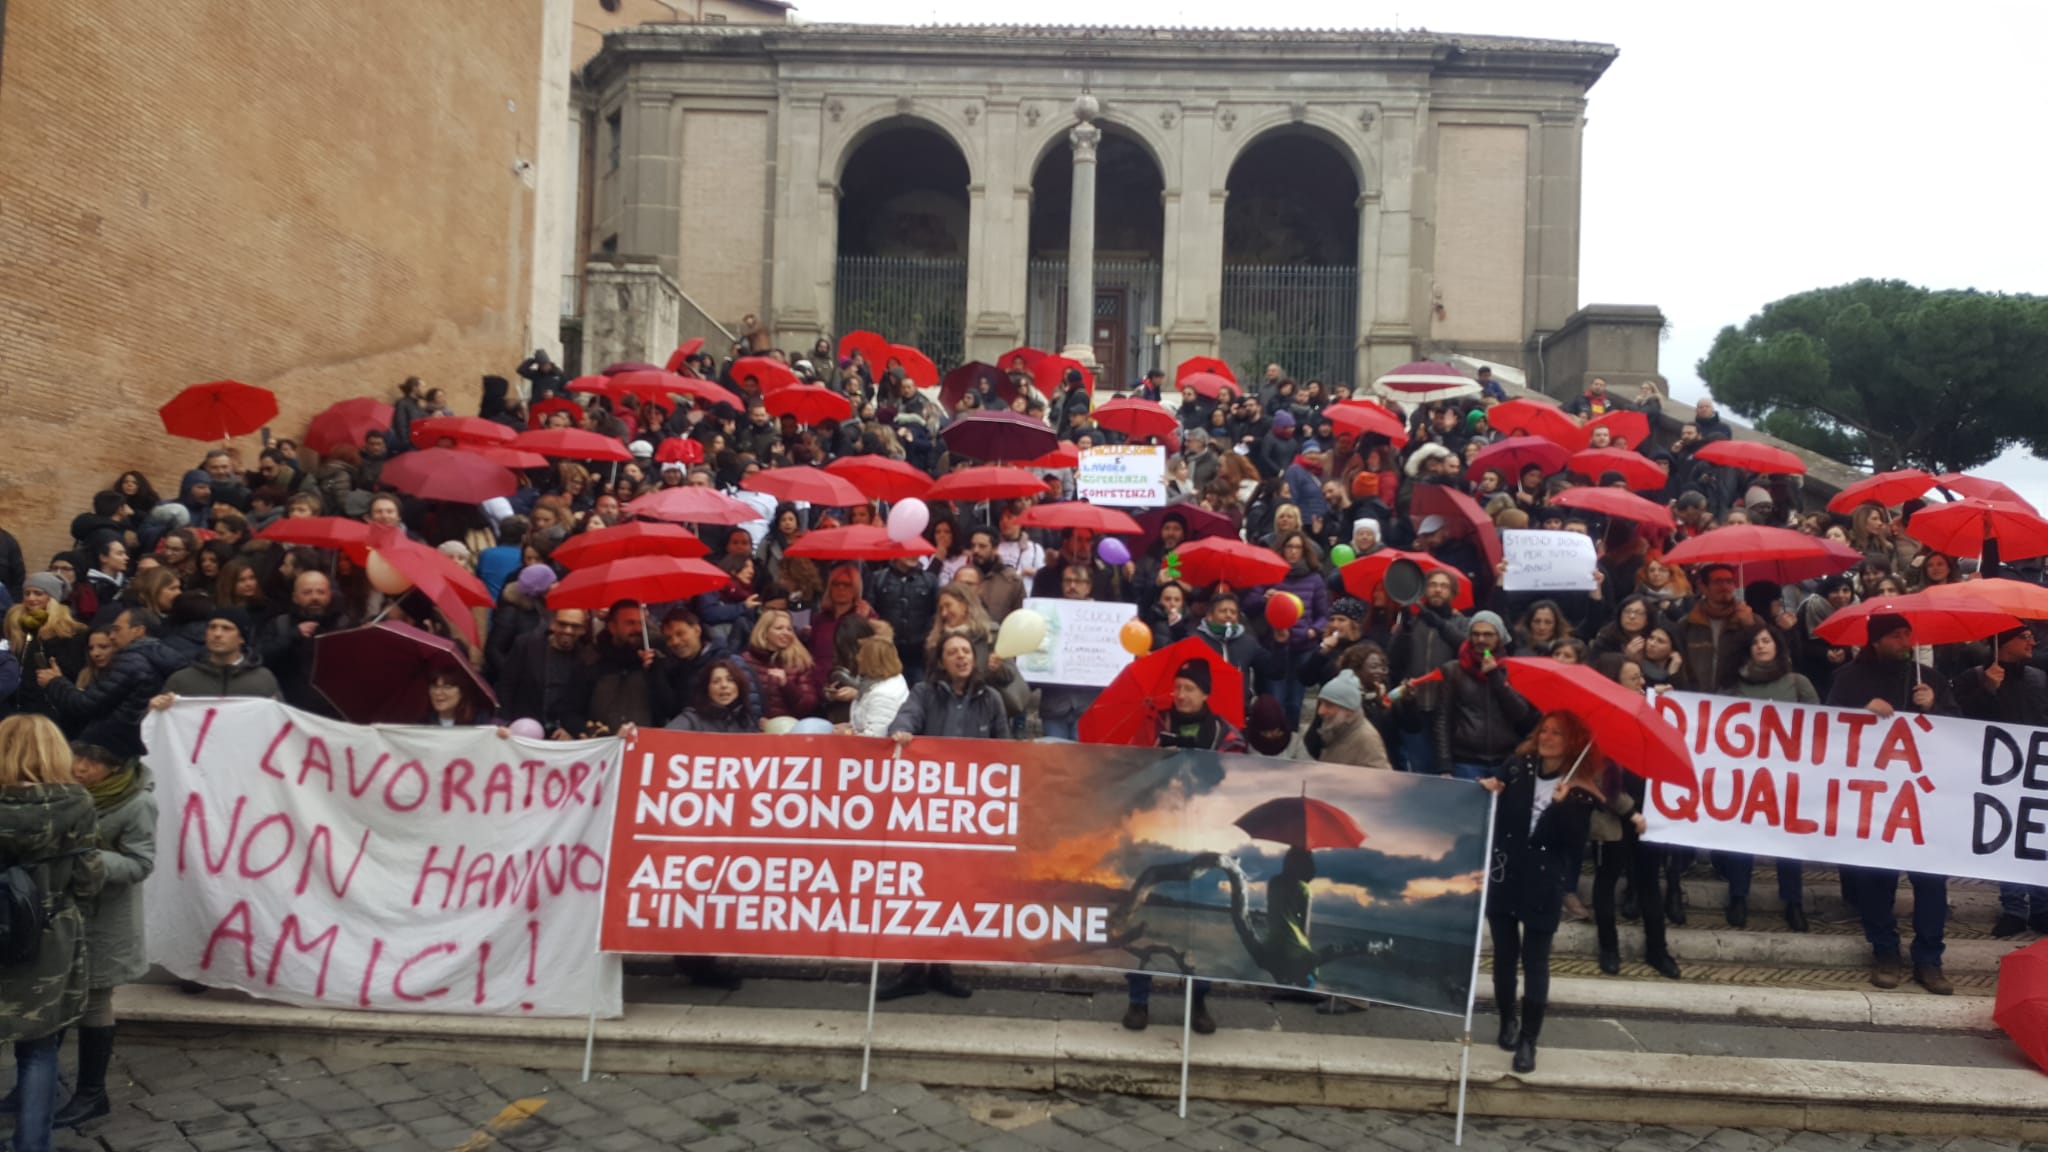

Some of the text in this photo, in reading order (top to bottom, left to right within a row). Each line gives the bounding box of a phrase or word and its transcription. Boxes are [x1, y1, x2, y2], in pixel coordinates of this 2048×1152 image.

[1080, 488, 1156, 499] COMPETENZA
[192, 708, 606, 813] I LAVORATORI
[640, 753, 1020, 798] I SERVIZI PUBBLICI
[635, 791, 1019, 835] NON SONO MERCI
[178, 792, 604, 912] NON HANNO
[627, 853, 925, 896] AEC/OEPA PER
[626, 892, 1108, 942] L'INTERNALIZZAZIONE
